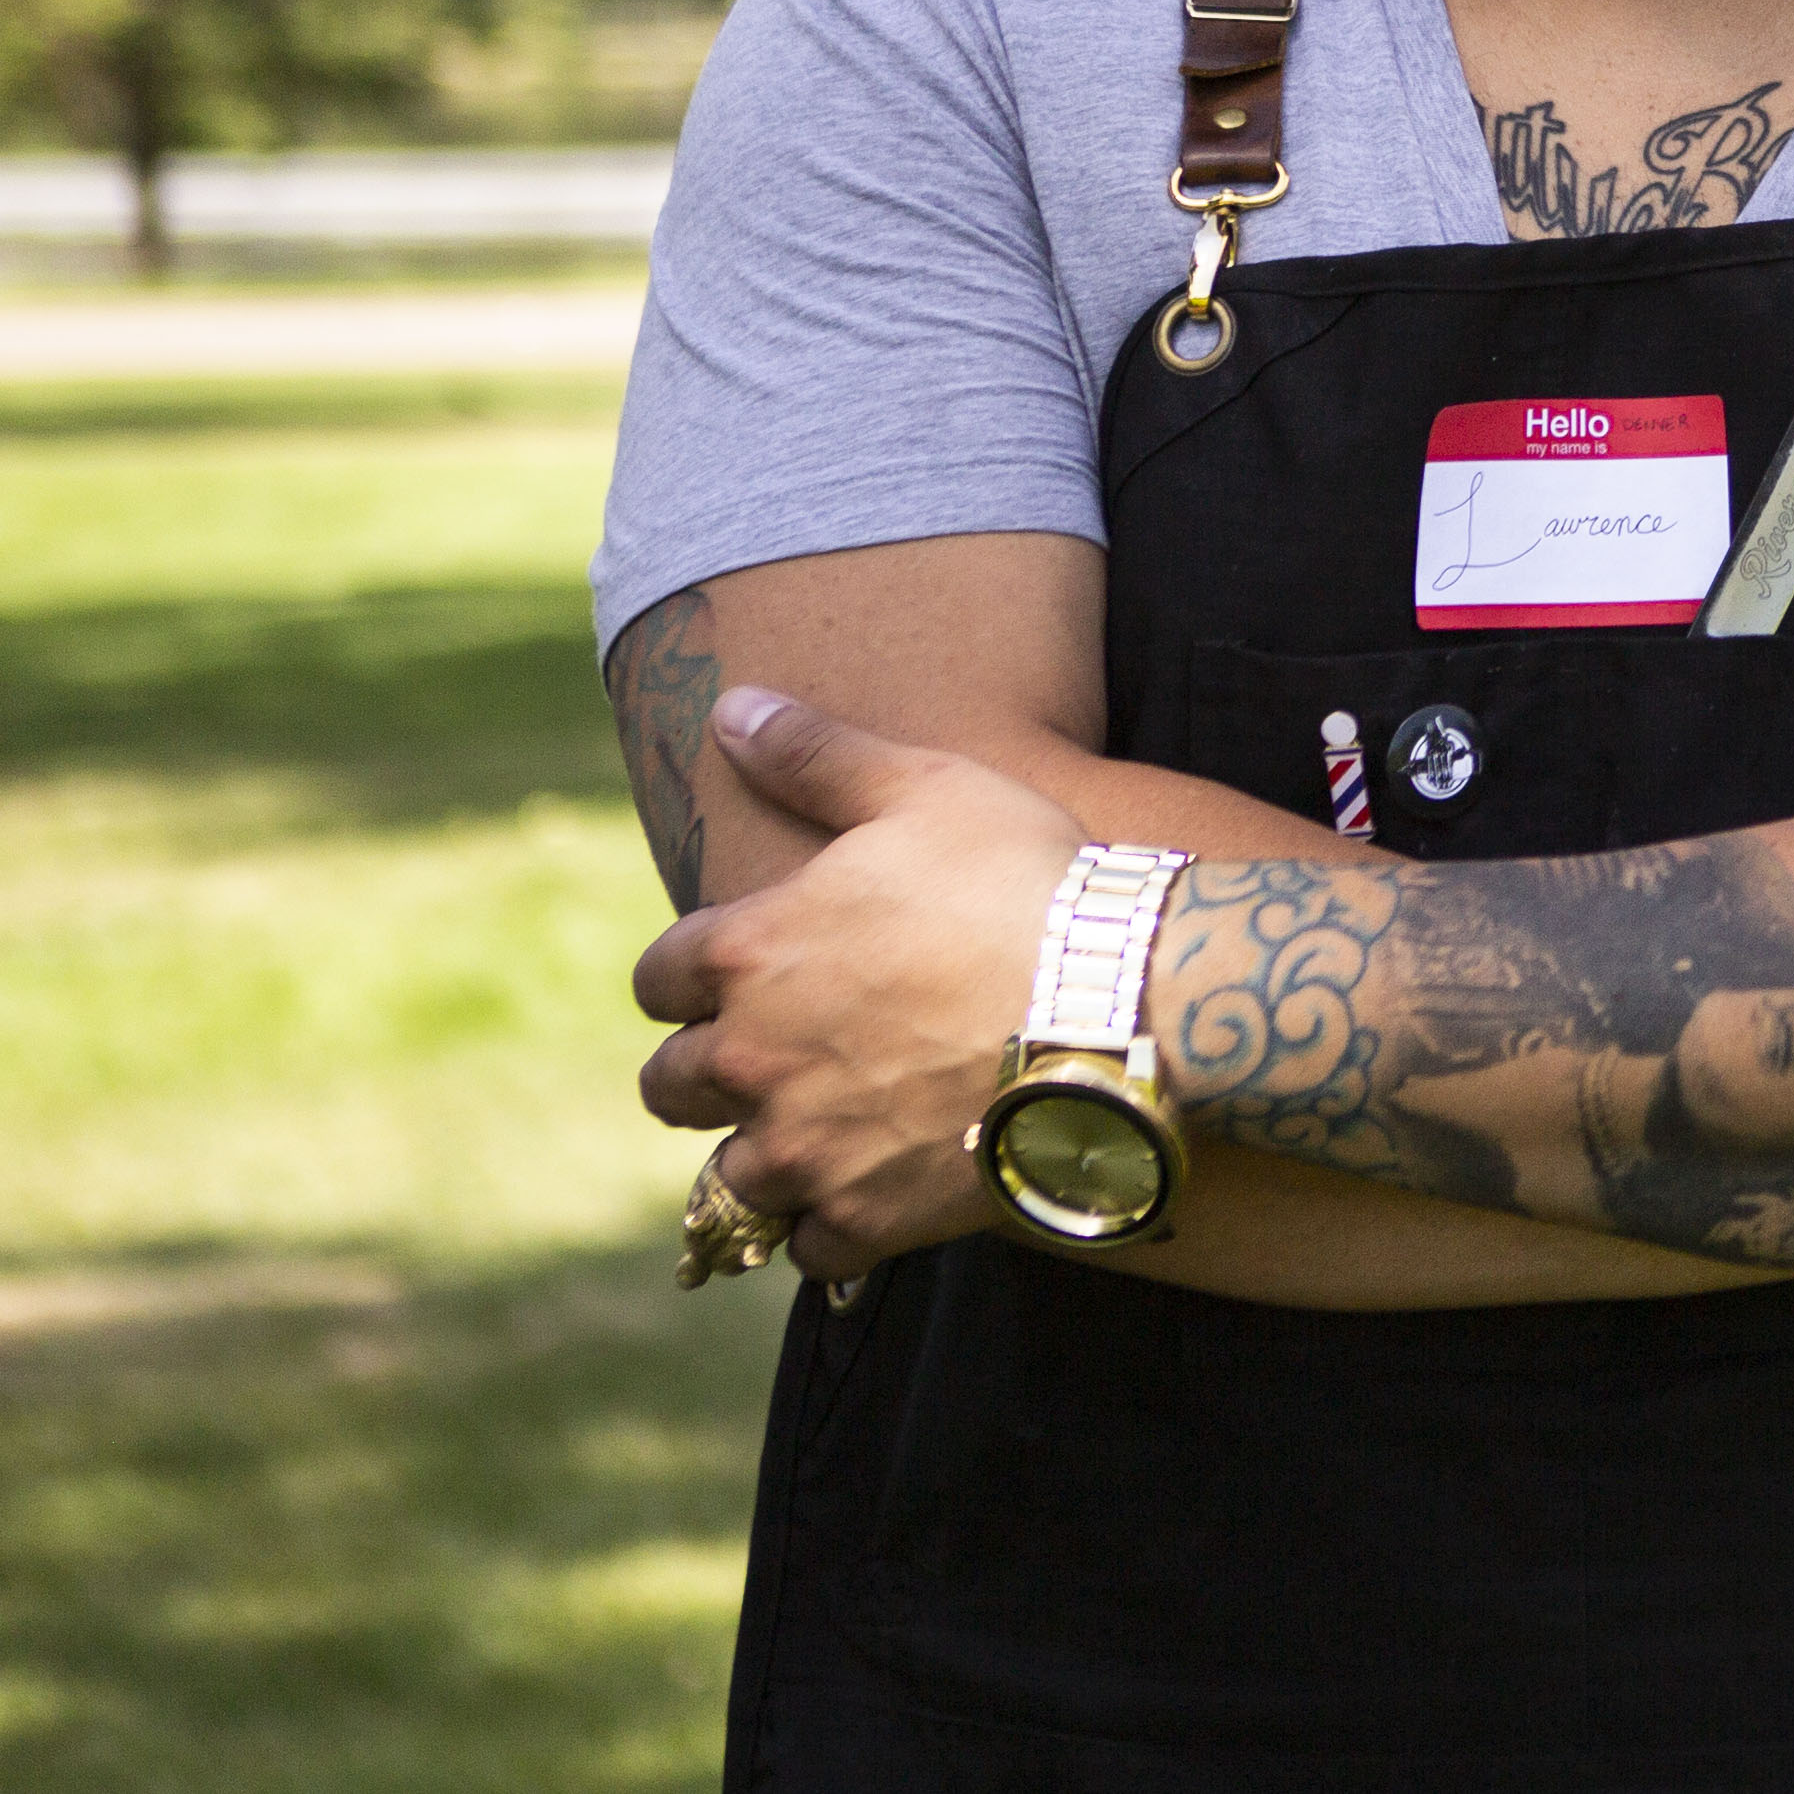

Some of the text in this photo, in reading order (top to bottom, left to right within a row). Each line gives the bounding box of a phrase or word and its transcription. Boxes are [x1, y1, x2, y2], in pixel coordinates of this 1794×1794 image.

[1525, 407, 1610, 438] Hello
[1526, 440, 1608, 458] my name is
